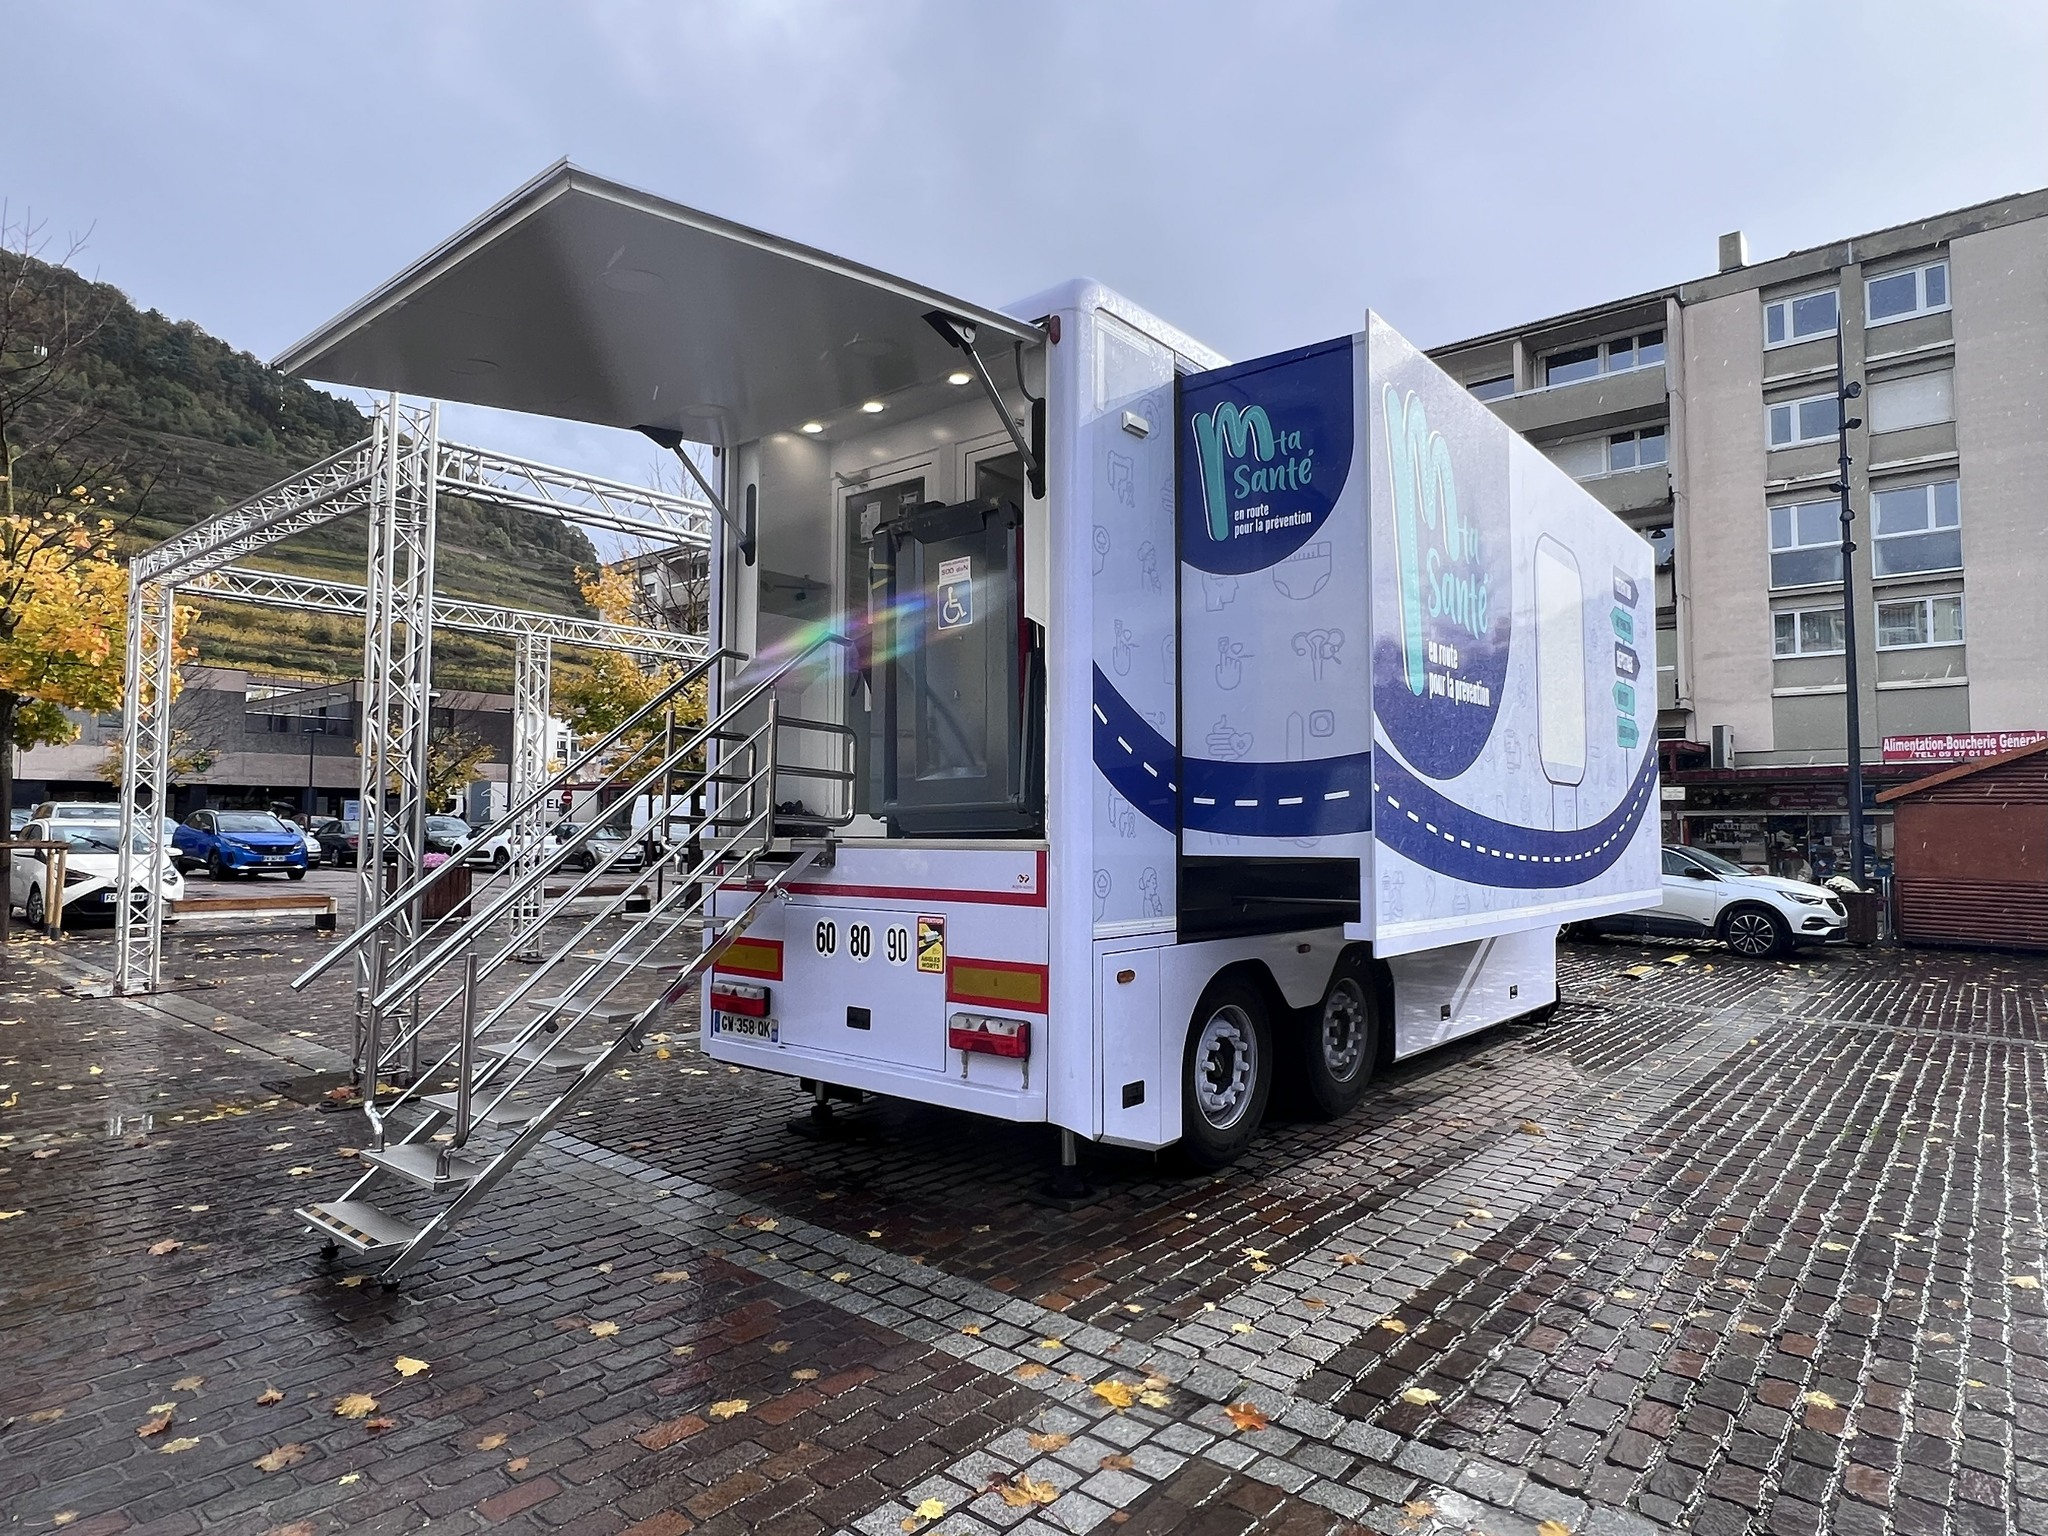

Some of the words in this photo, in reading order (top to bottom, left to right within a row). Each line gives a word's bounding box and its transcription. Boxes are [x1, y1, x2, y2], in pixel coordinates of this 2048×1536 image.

[1233, 448, 1314, 500] Santé
[1234, 508, 1245, 522] en
[1246, 504, 1270, 520] route
[1234, 521, 1254, 539] pour
[1255, 519, 1264, 533] la
[1265, 511, 1312, 534] prévention
[1426, 547, 1489, 640] Santé
[1428, 639, 1438, 663] en
[1438, 642, 1459, 669] route
[1428, 671, 1446, 700] pour
[1446, 672, 1455, 698] la
[1455, 673, 1491, 709] prévention
[1883, 734, 1997, 752] Alimentation-Boucherie
[816, 921, 836, 954] 60
[850, 924, 871, 957] 80
[887, 927, 908, 962] 90
